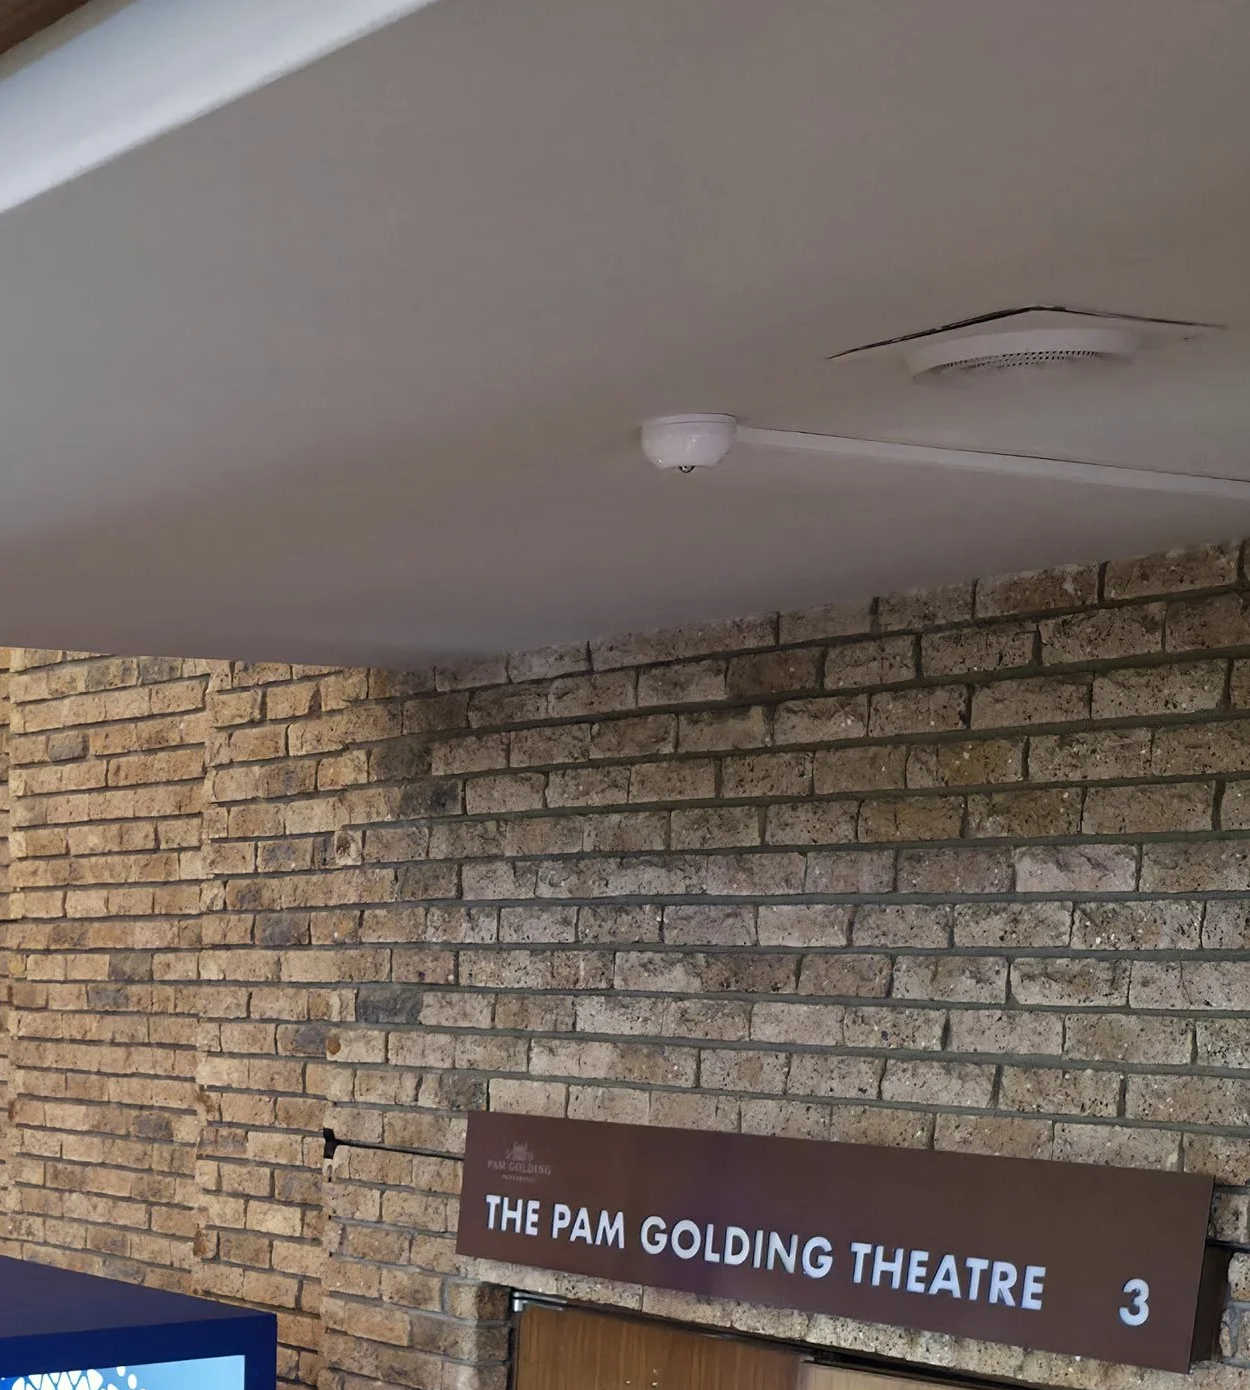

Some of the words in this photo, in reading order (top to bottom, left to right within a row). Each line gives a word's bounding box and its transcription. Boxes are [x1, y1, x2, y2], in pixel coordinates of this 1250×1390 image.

[485, 1194, 541, 1237] THE
[551, 1204, 626, 1250] PAM
[640, 1215, 833, 1280] GOLDING
[850, 1242, 1047, 1311] THEATRE
[1118, 1278, 1151, 1327] 3
